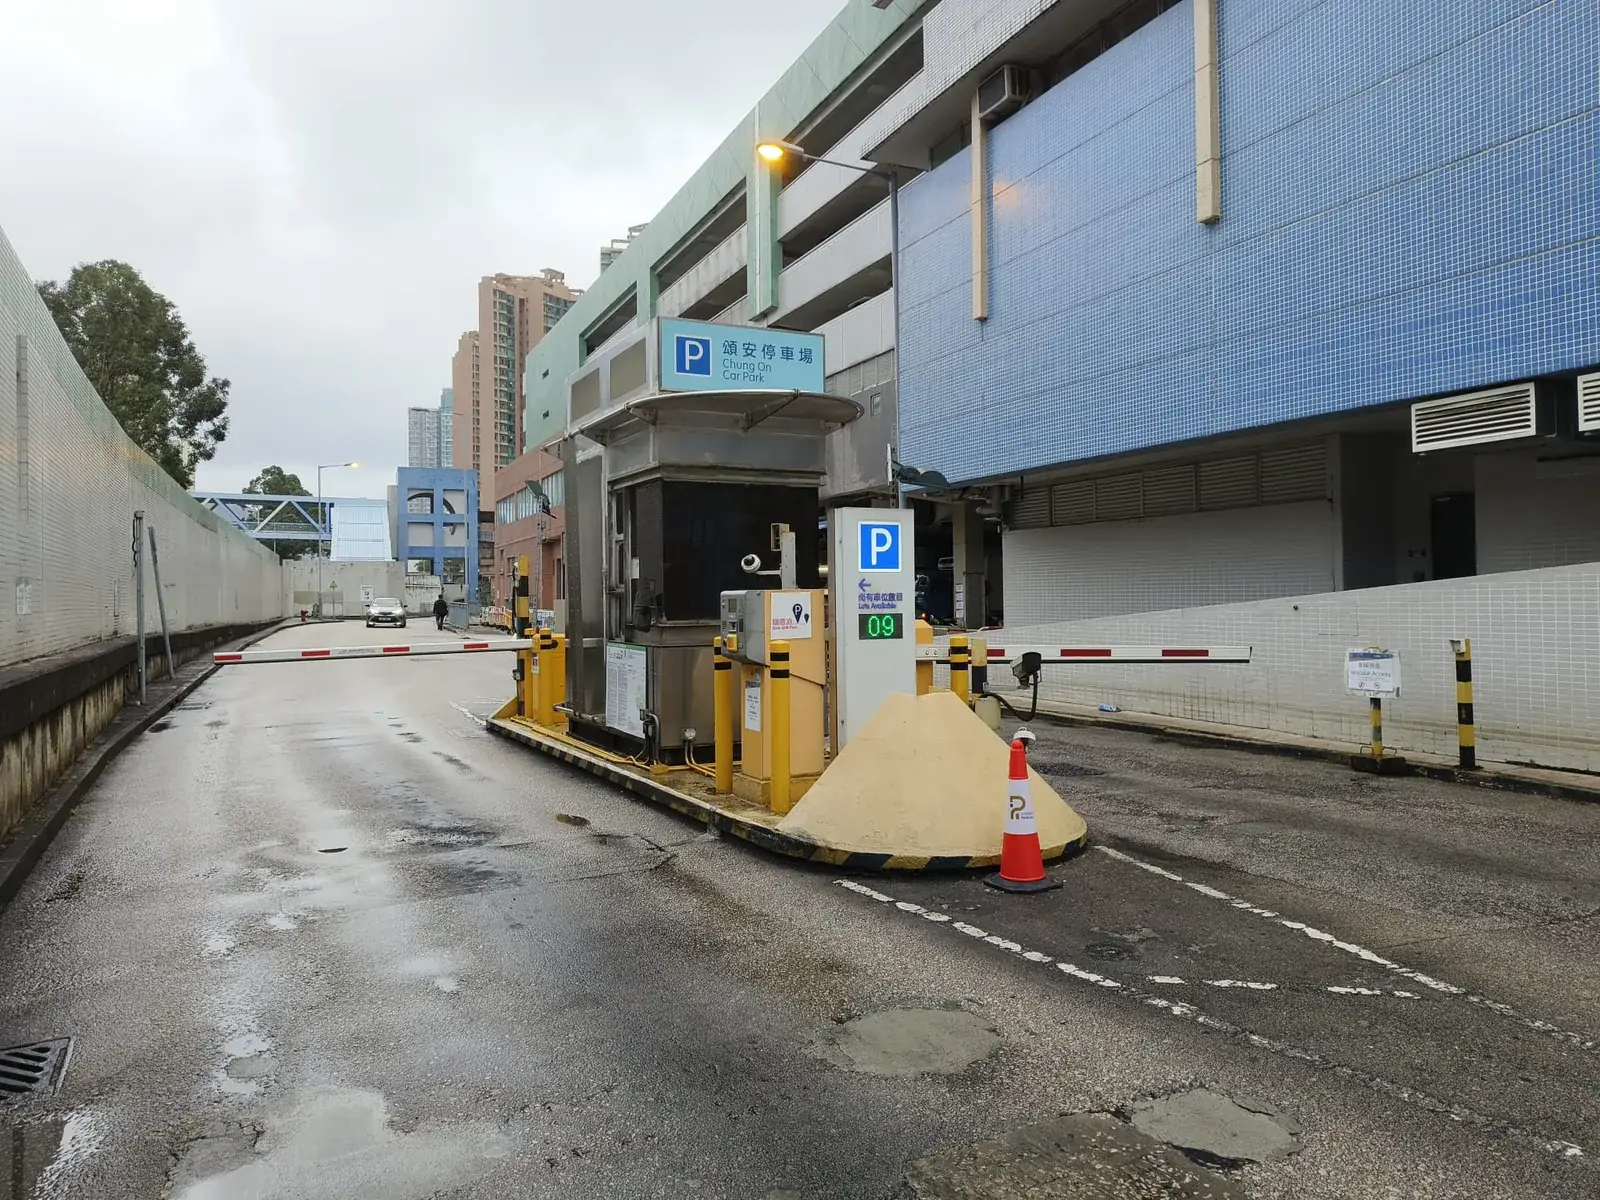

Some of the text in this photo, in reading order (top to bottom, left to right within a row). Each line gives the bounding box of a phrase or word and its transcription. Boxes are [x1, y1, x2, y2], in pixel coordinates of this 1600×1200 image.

[685, 340, 704, 370] P
[722, 339, 813, 364] 頌安停車場
[722, 358, 772, 373] Chung On
[722, 371, 765, 383] Car Park
[871, 528, 892, 566] P
[868, 615, 894, 637] 09
